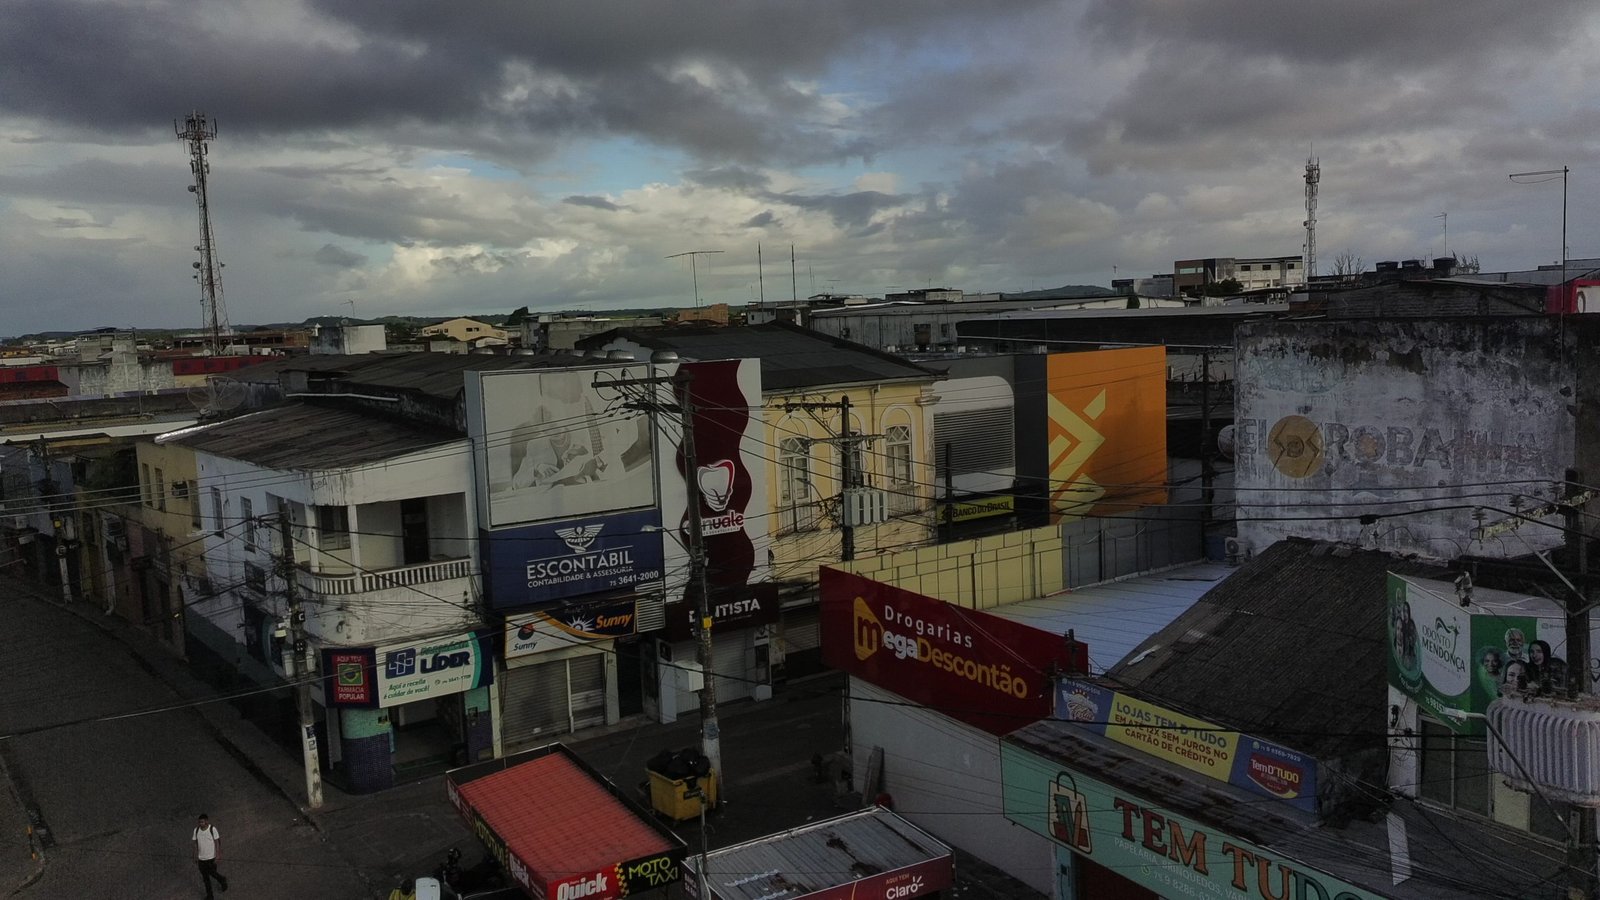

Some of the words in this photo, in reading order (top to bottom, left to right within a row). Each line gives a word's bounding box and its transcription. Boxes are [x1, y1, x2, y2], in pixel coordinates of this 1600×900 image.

[952, 506, 976, 518] BANCO
[987, 501, 1010, 513] BRASIL
[526, 548, 634, 580] ESCONTÁBIL
[528, 573, 584, 589] CONTABILIDADE
[586, 571, 592, 579] &
[592, 565, 634, 578] ASSESSORIA
[618, 570, 659, 585] 3641-2000
[595, 613, 633, 629] Sunny
[884, 604, 973, 648] Drogarias
[513, 641, 538, 651] Sunny
[1422, 625, 1450, 648] ODONTO
[420, 651, 470, 674] LÍDER
[1421, 636, 1466, 673] MENDONÇA
[388, 682, 402, 691] Aqui
[388, 690, 405, 699] cuidar
[1116, 702, 1152, 722] LOJAS
[1153, 714, 1177, 730] TEM
[1114, 714, 1126, 723] EM
[1128, 718, 1144, 731] ATÉ
[1146, 725, 1160, 736] 12X
[1161, 731, 1180, 744] SEM
[1181, 738, 1212, 755] JUROS
[1213, 749, 1228, 760] NO
[1125, 728, 1160, 746] CARTÃO
[1161, 741, 1173, 752] DE
[1174, 746, 1215, 767] CRÉDITO
[1113, 797, 1209, 876] TEM
[628, 856, 671, 880] MOTO
[645, 865, 679, 887] TAXI
[885, 877, 898, 885] AQUI
[898, 873, 910, 881] TEM
[1161, 859, 1223, 896] BRINQUEDOS,
[557, 872, 608, 900] Quick
[885, 882, 919, 900] Claro
